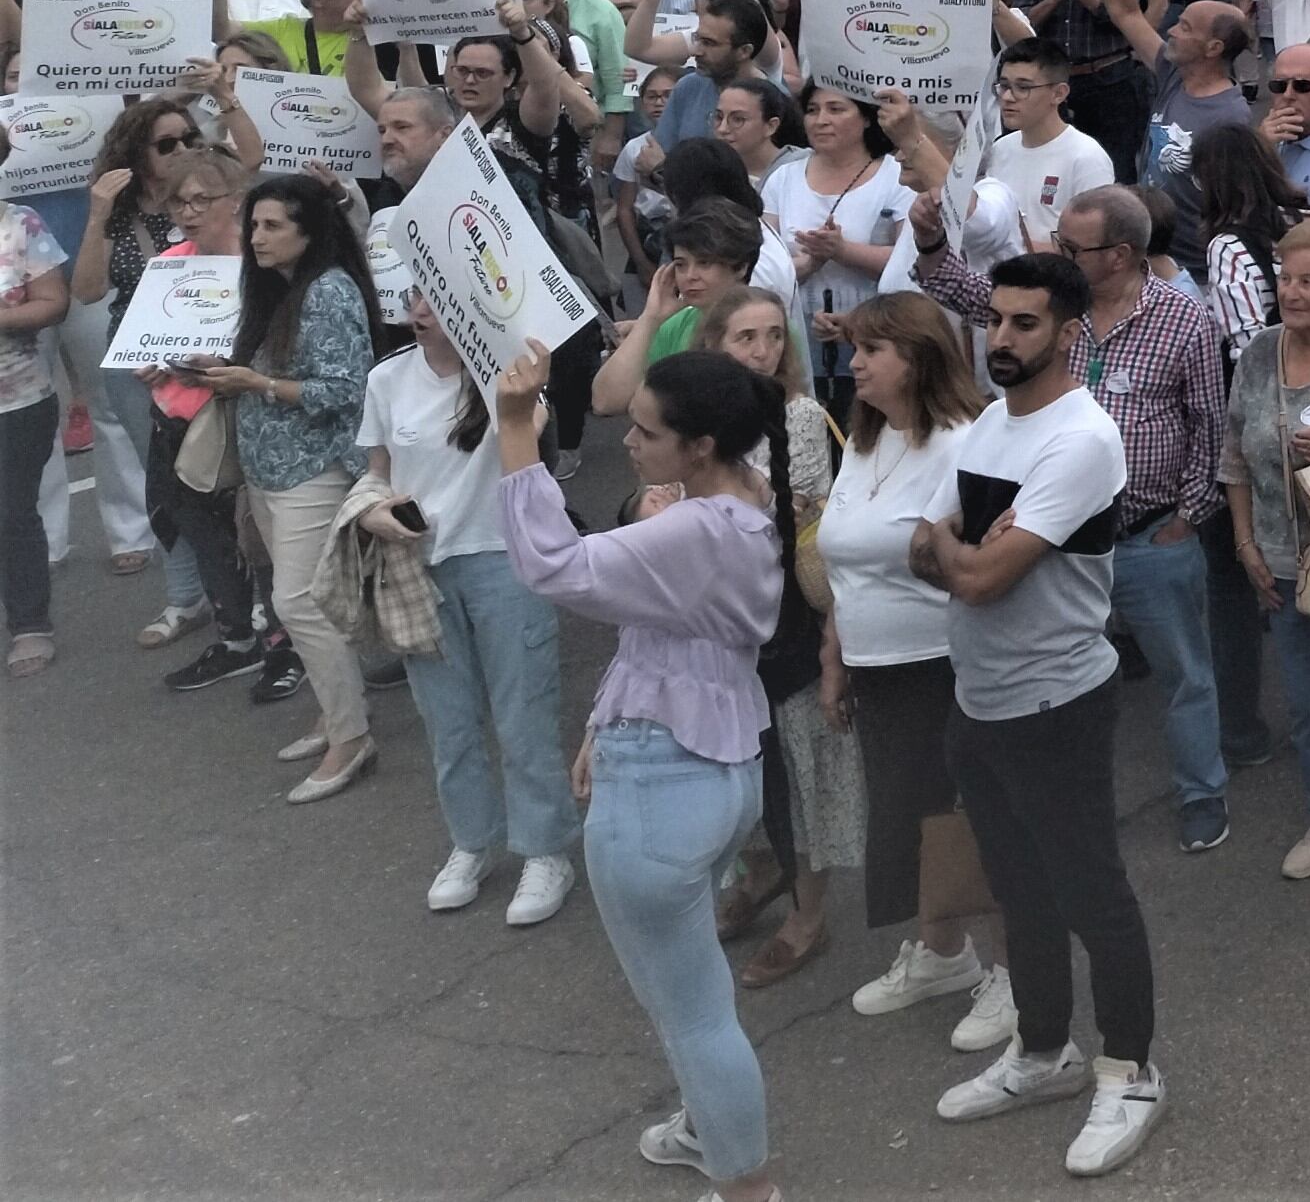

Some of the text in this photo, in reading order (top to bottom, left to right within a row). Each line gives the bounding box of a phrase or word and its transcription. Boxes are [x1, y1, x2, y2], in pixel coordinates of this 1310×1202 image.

[846, 0, 902, 15] Don Benito
[36, 63, 102, 78] Quiero
[108, 65, 132, 76] un
[836, 64, 953, 90] Quiero a mis
[55, 76, 178, 91] en mi ciudad
[923, 91, 950, 105] de
